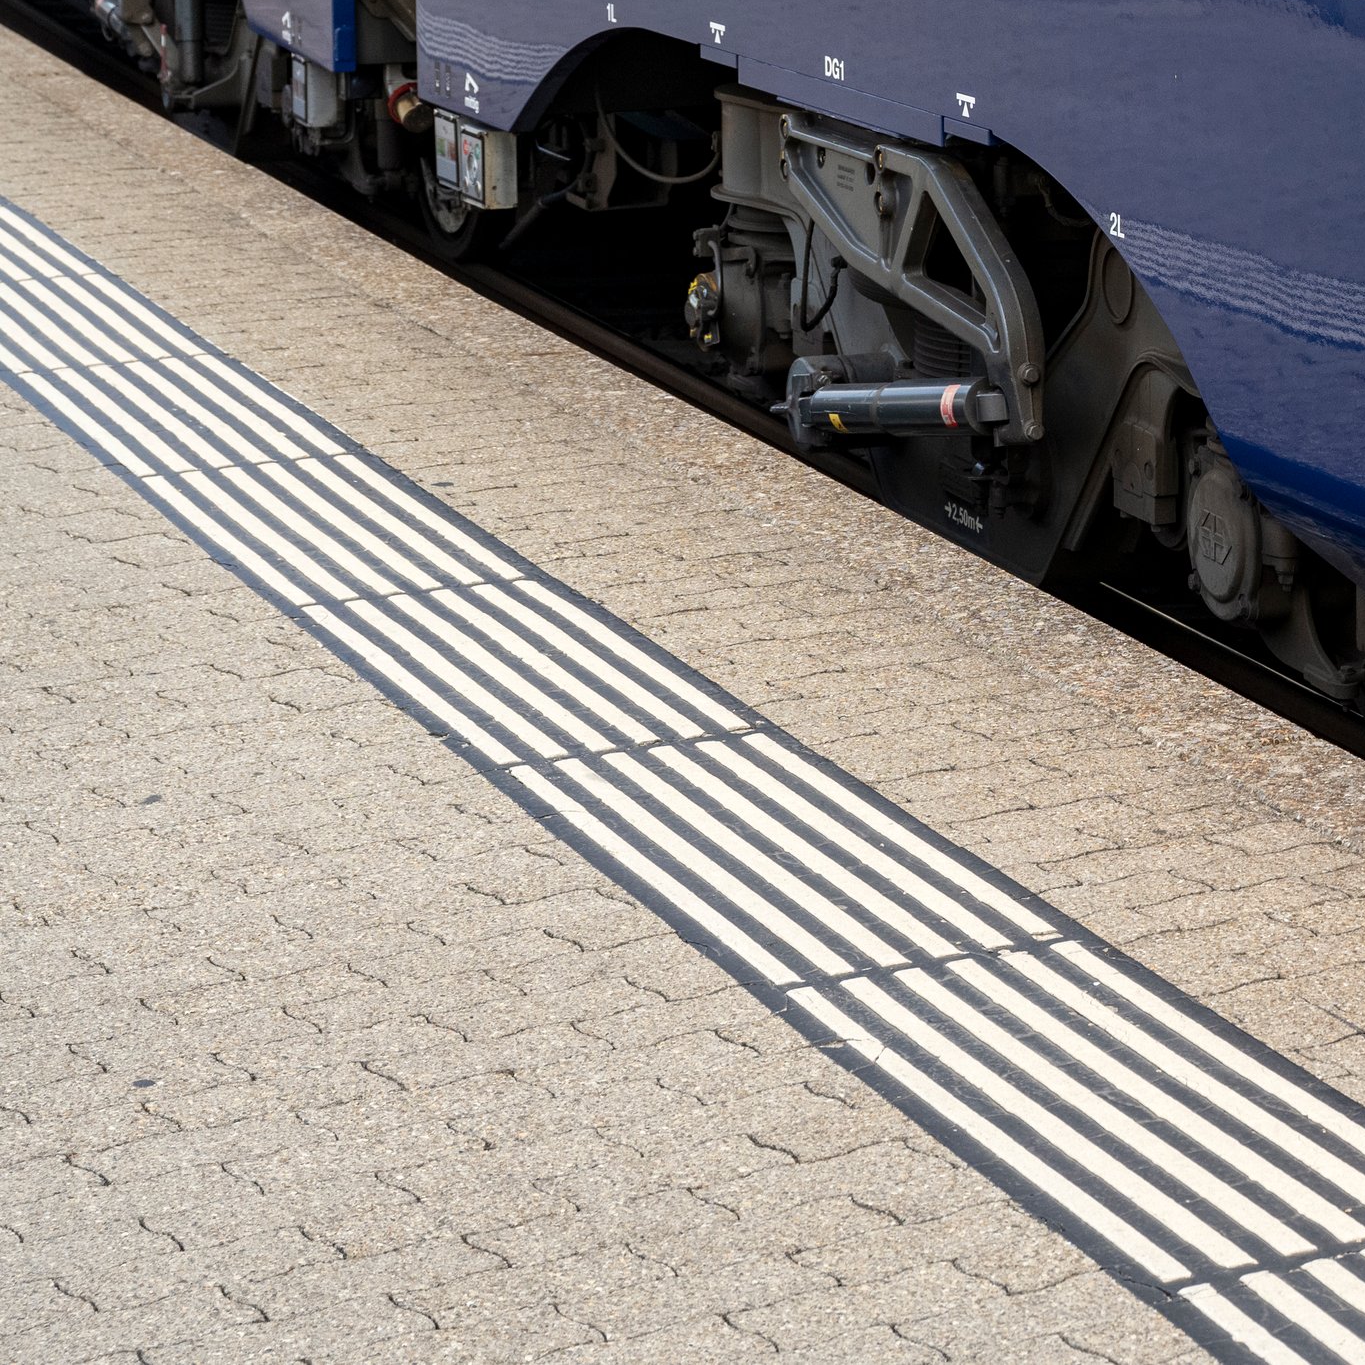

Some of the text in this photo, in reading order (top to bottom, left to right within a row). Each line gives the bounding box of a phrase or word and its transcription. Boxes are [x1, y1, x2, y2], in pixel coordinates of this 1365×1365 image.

[606, 2, 617, 23] 1L
[825, 55, 844, 81] DG1
[1110, 212, 1125, 239] 2L
